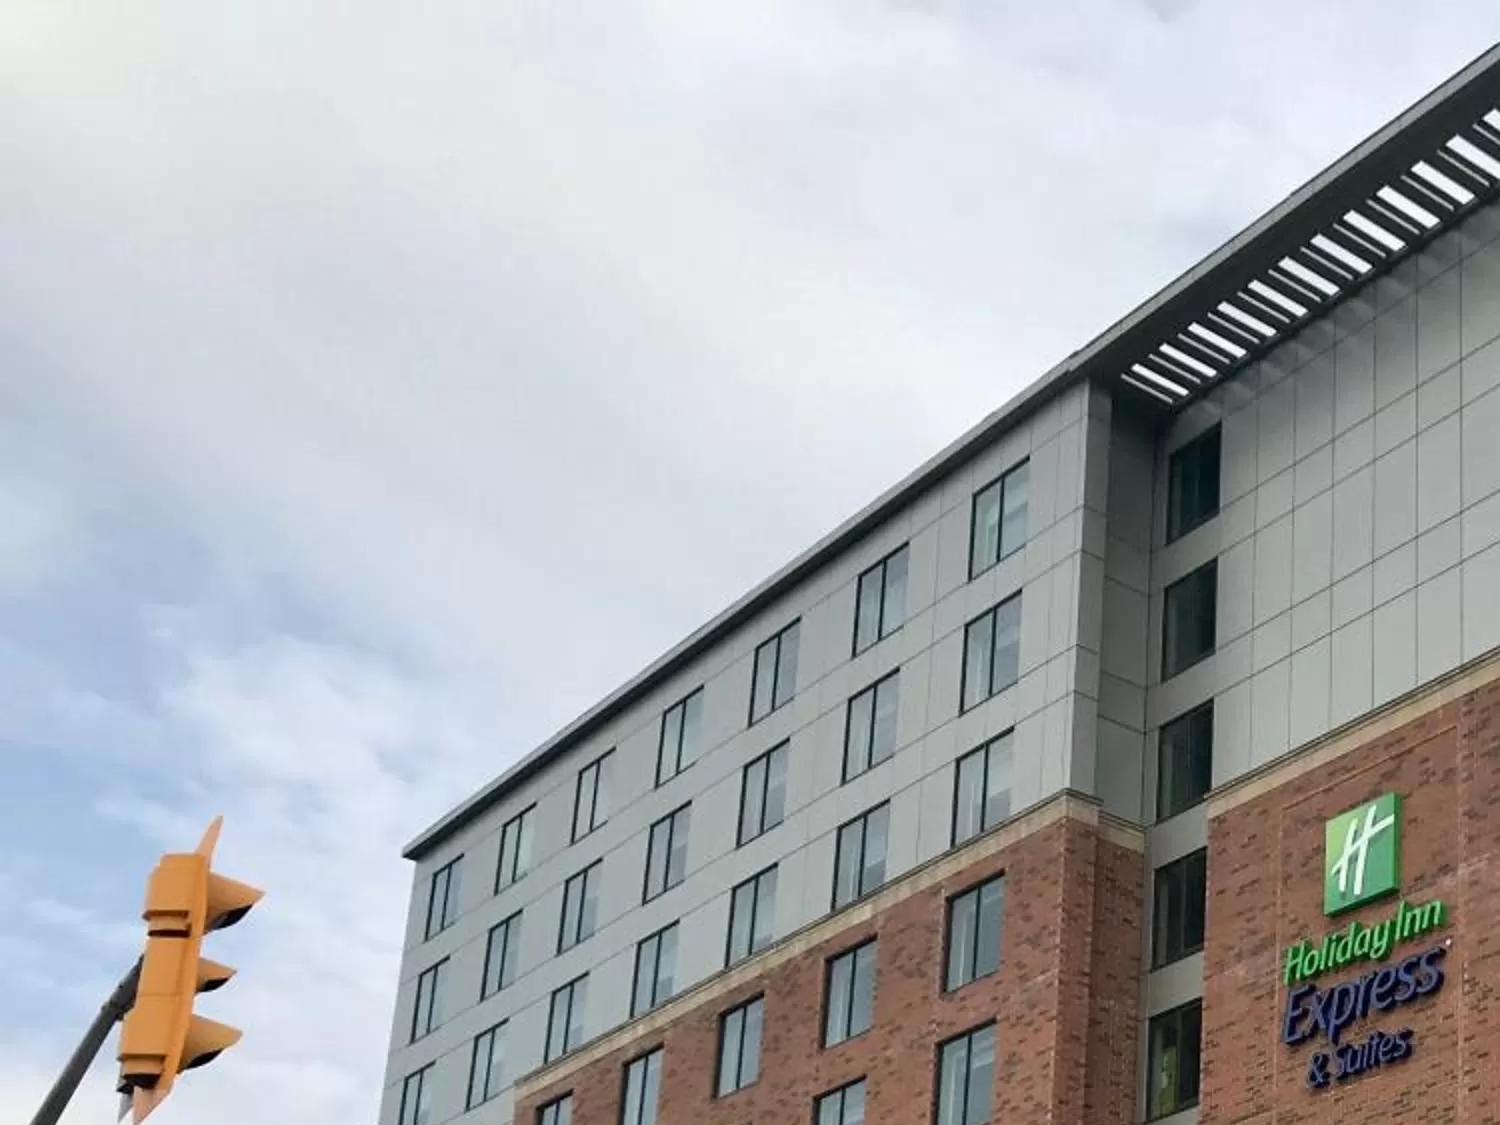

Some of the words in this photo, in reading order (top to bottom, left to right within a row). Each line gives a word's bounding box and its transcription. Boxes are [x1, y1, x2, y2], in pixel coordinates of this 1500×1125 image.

[1332, 804, 1395, 896] H
[1284, 918, 1392, 985] Holiday
[1394, 898, 1447, 942] Inn
[1282, 944, 1447, 1046] Express
[1307, 1051, 1330, 1089] &
[1332, 1027, 1413, 1079] Suites
